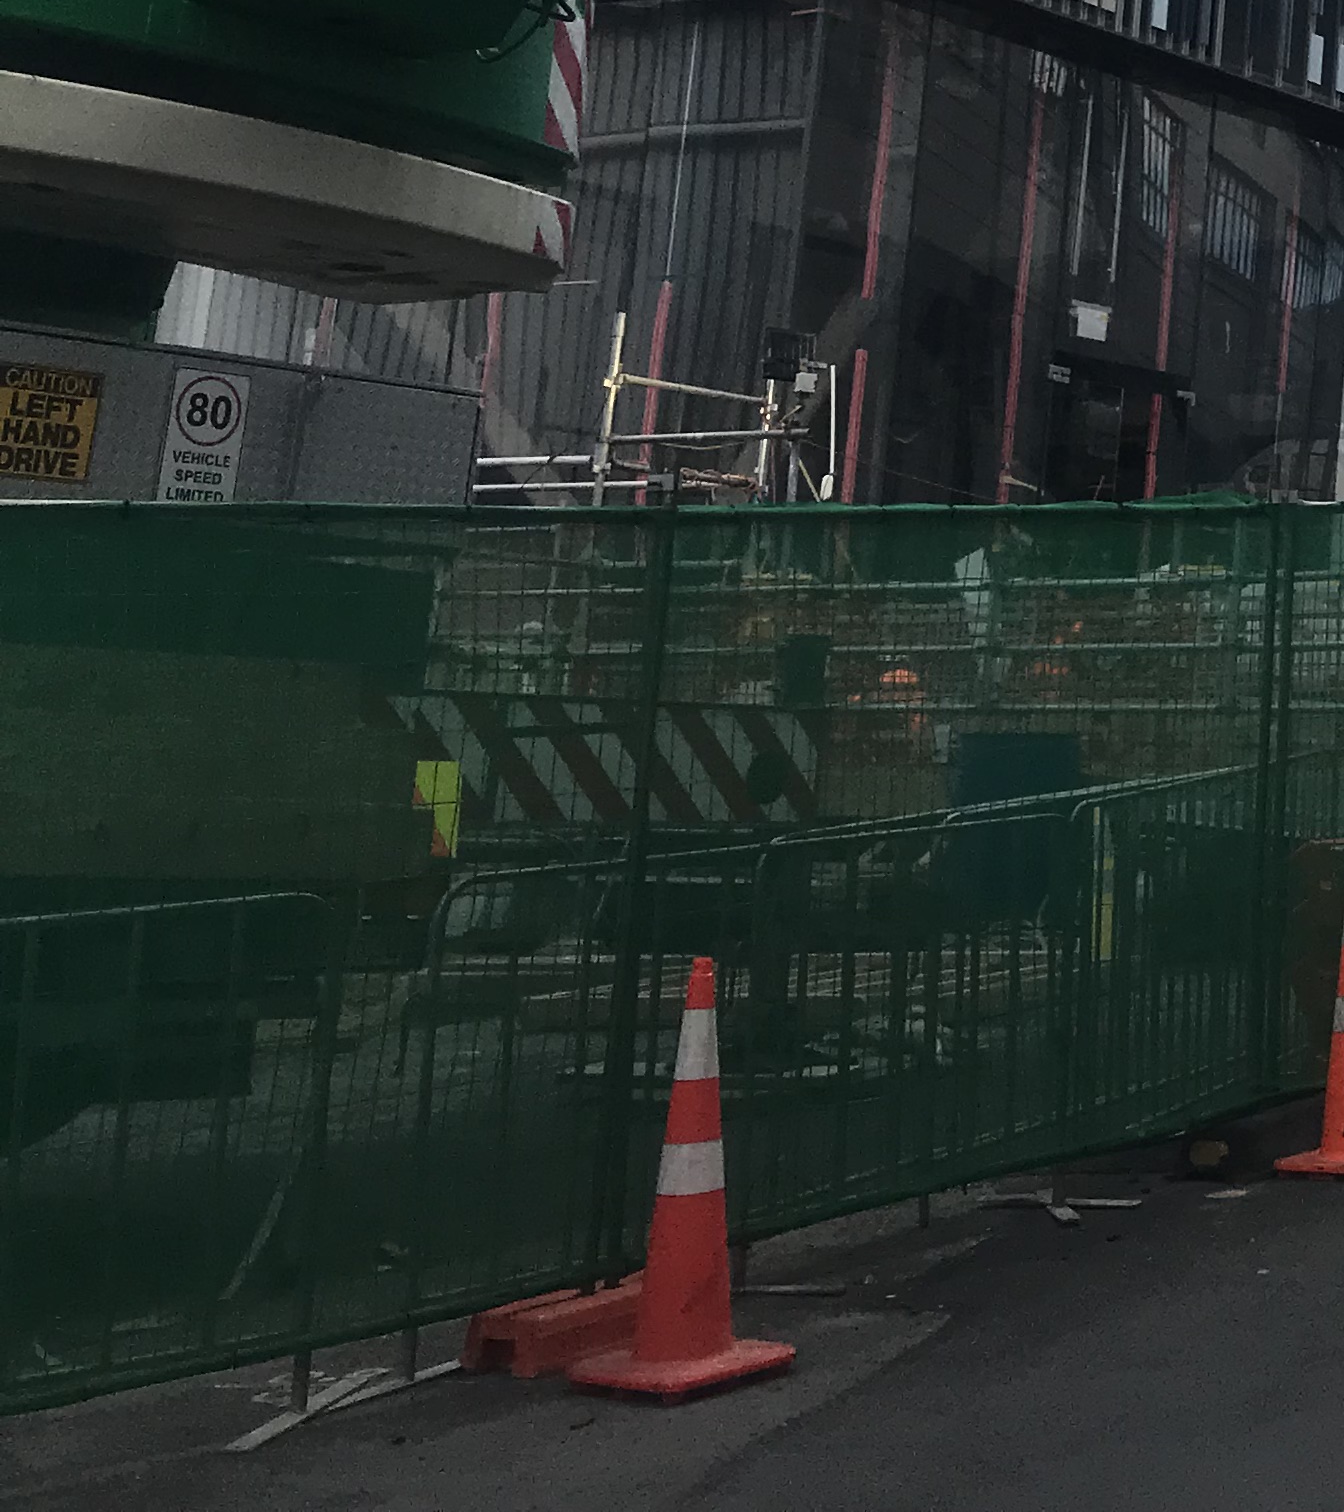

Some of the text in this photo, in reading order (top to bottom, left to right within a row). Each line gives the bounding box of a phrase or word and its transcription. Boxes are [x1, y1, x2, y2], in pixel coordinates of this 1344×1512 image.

[5, 368, 92, 395] CAUTION
[10, 390, 84, 422] LEFT
[186, 392, 232, 429] 80
[1, 418, 81, 449] HAND
[0, 444, 79, 477] DRIVE
[172, 449, 231, 469] VEHICLE
[174, 468, 223, 486] SPEED
[165, 486, 224, 502] LIMITED
